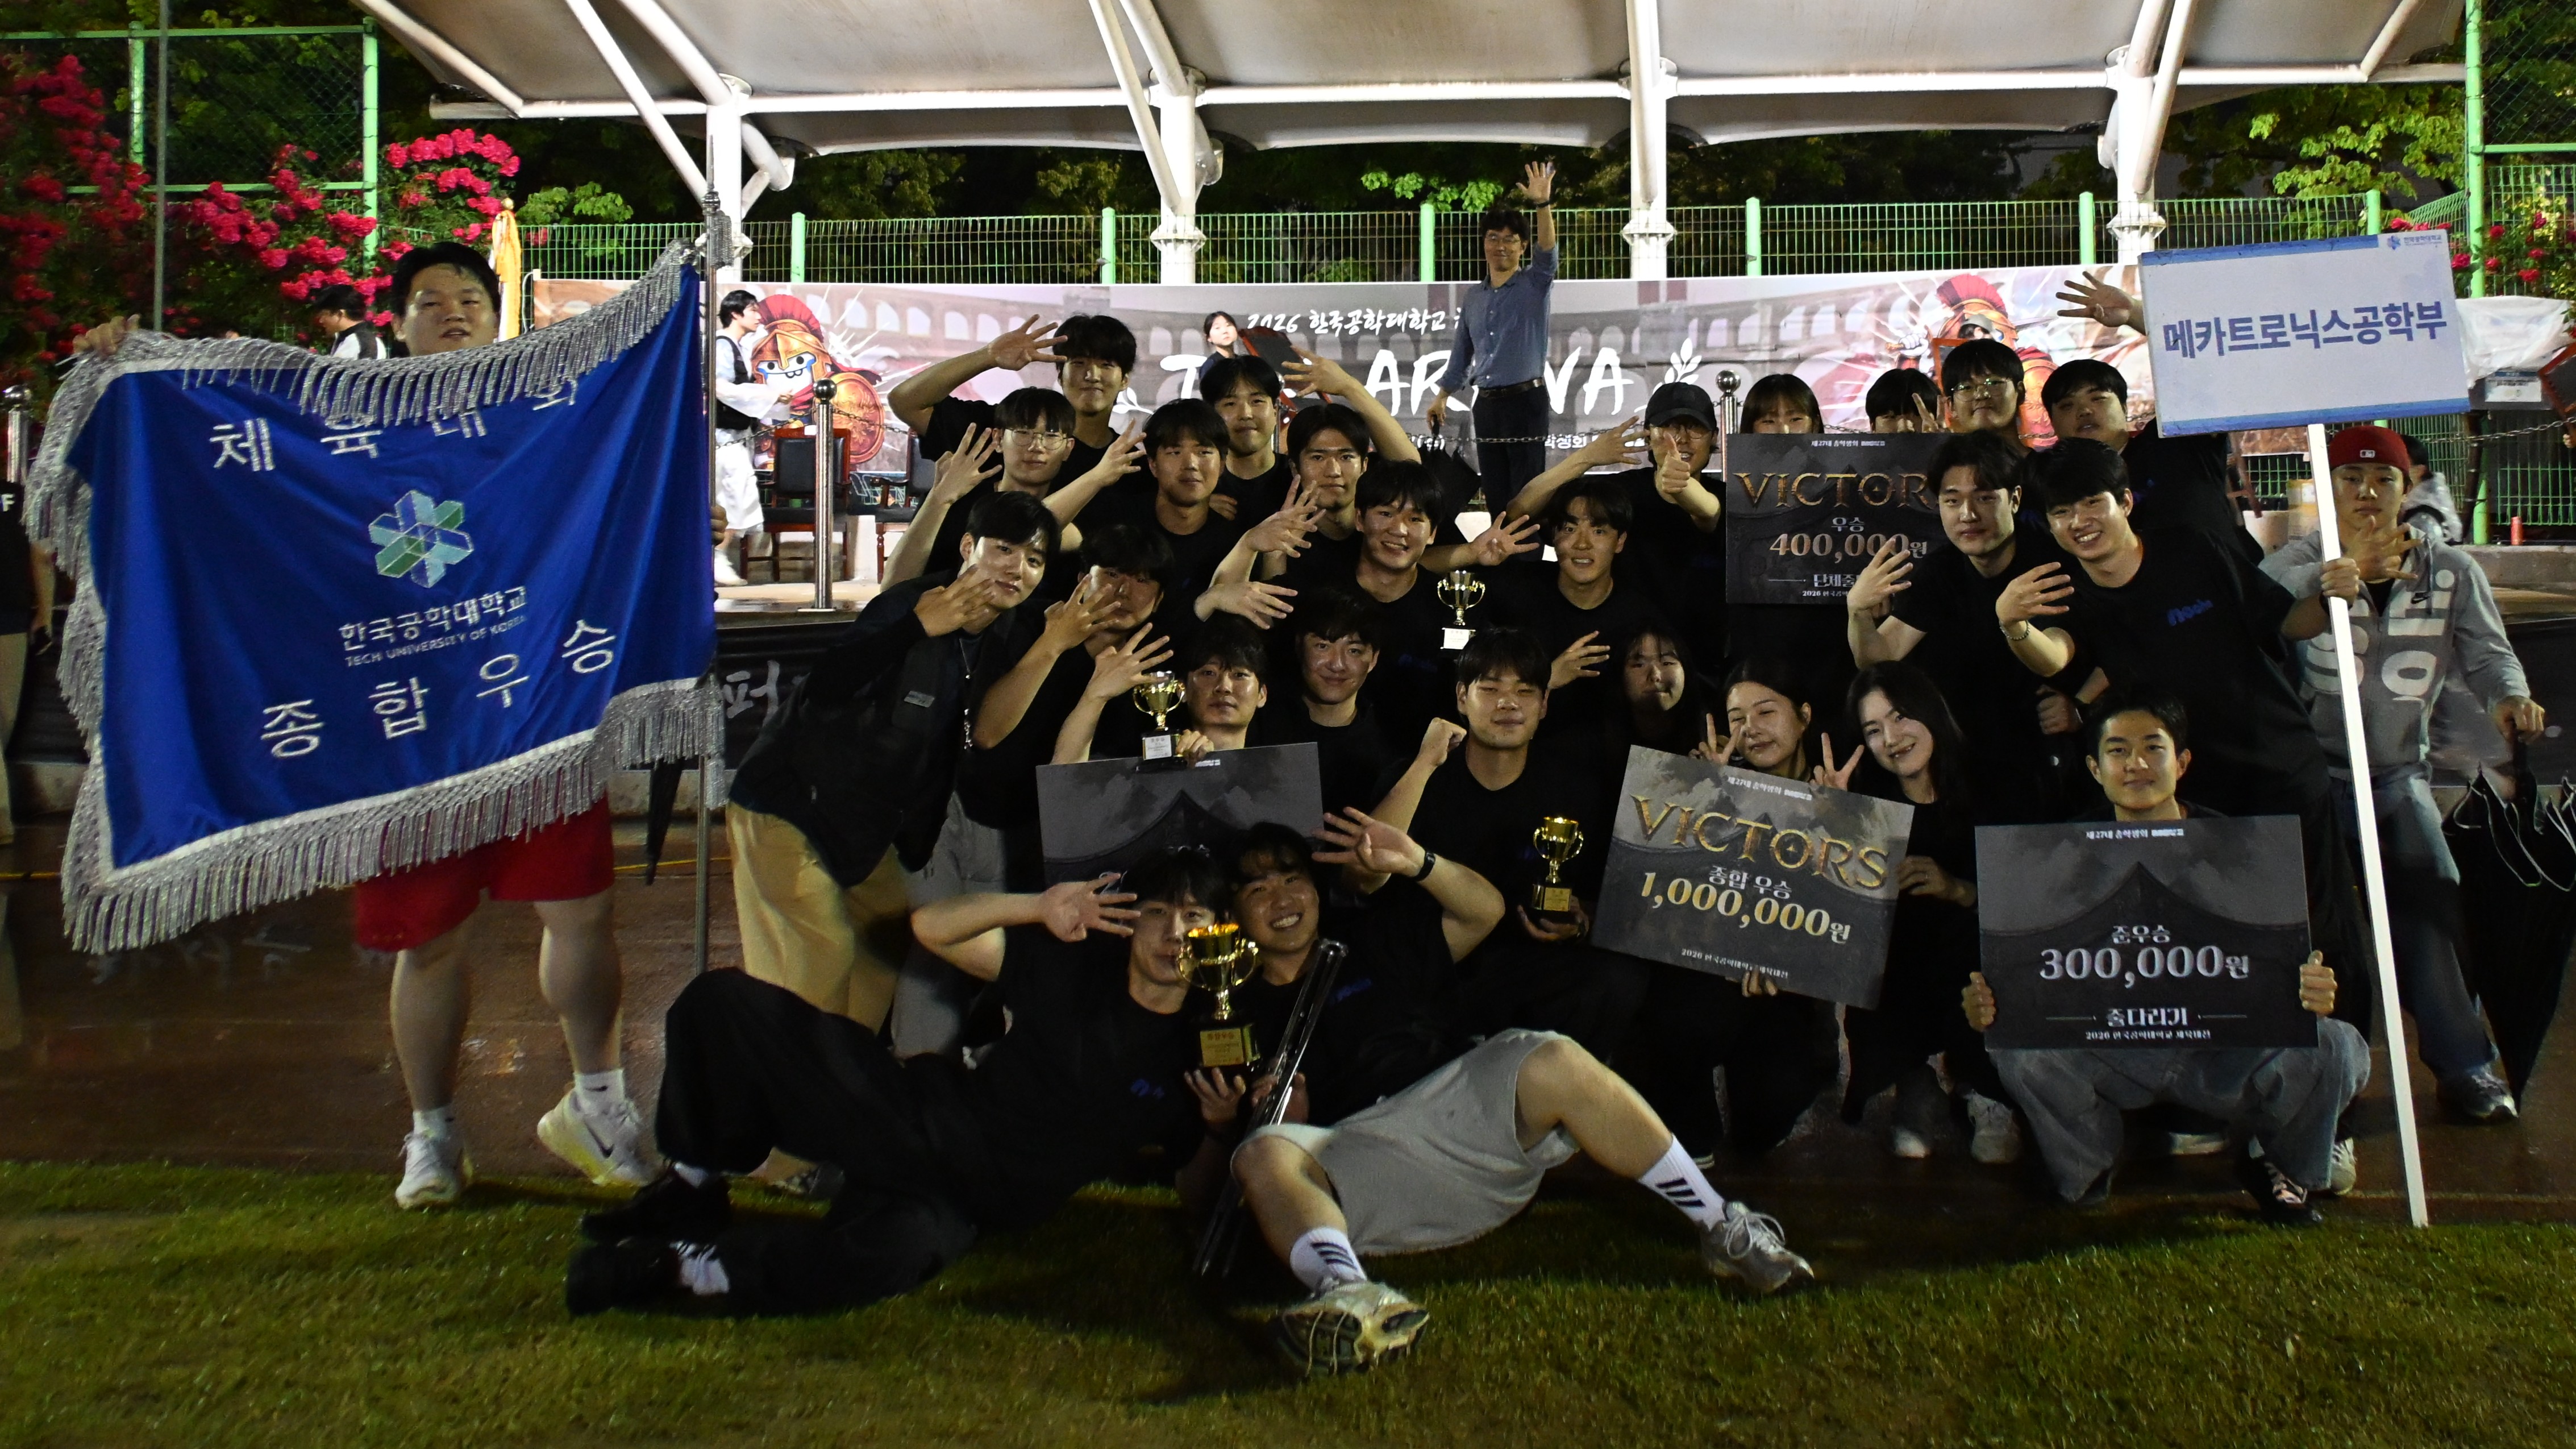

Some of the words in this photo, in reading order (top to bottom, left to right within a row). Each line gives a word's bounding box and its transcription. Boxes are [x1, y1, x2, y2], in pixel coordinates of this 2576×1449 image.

[1309, 308, 1446, 337] 한국공학대학교
[2163, 301, 2446, 358] 메카트로닉스공학부
[1364, 349, 1634, 416] ARNA
[1545, 434, 1587, 449] 학생회
[1733, 473, 1937, 509] VICTOR
[1831, 517, 1865, 533] 우승
[1769, 533, 1928, 563] 400,000원
[1813, 574, 1859, 588] 단체줄
[339, 586, 527, 651] 한국공학대학교
[345, 653, 382, 667] TECH
[386, 633, 467, 659] UNIVERSITY
[469, 628, 487, 641] OF
[490, 615, 527, 634] KOREA
[1630, 794, 1888, 891] VICTORS
[1708, 864, 1748, 890] 종합
[1753, 876, 1792, 900] 우승
[1640, 871, 1851, 945] 1,000,000원
[2112, 924, 2171, 944] 준우승
[2040, 945, 2249, 989] 300,000원
[2107, 1008, 2188, 1027] 줄다리기
